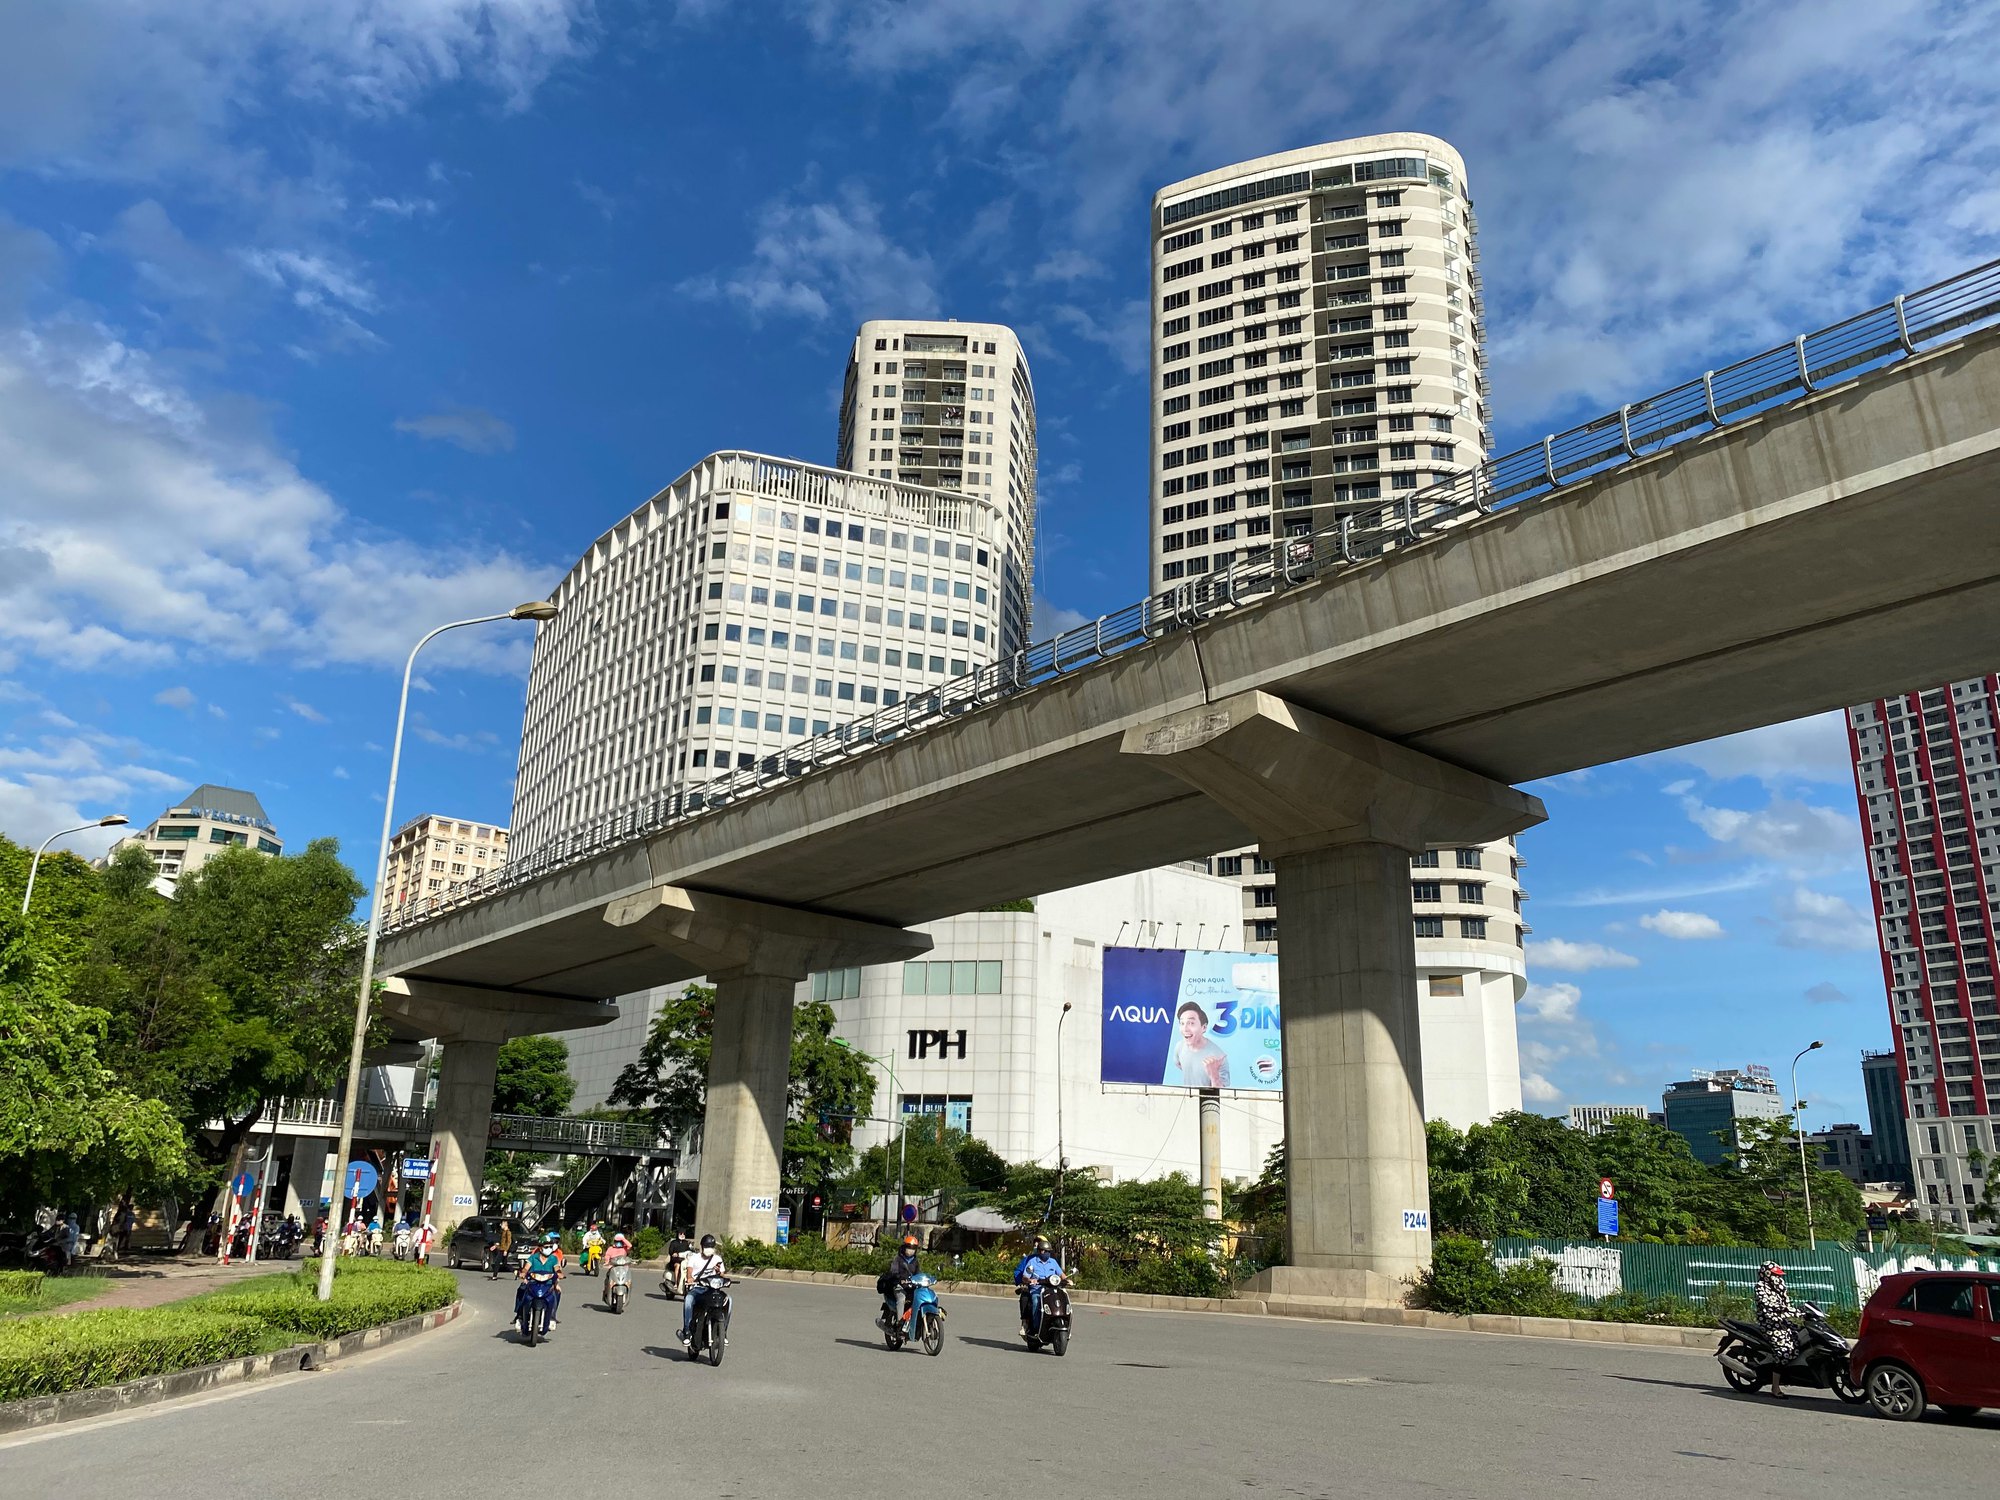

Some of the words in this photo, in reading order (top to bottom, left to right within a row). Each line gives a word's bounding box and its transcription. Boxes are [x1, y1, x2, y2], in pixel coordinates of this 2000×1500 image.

[191, 805, 233, 823] RIVERA
[1109, 1005, 1170, 1024] AQUA
[1212, 1000, 1238, 1035] 3
[906, 1029, 967, 1059] IPH
[454, 1196, 472, 1205] P246
[750, 1198, 772, 1210] P245
[1404, 1211, 1427, 1228] P244
